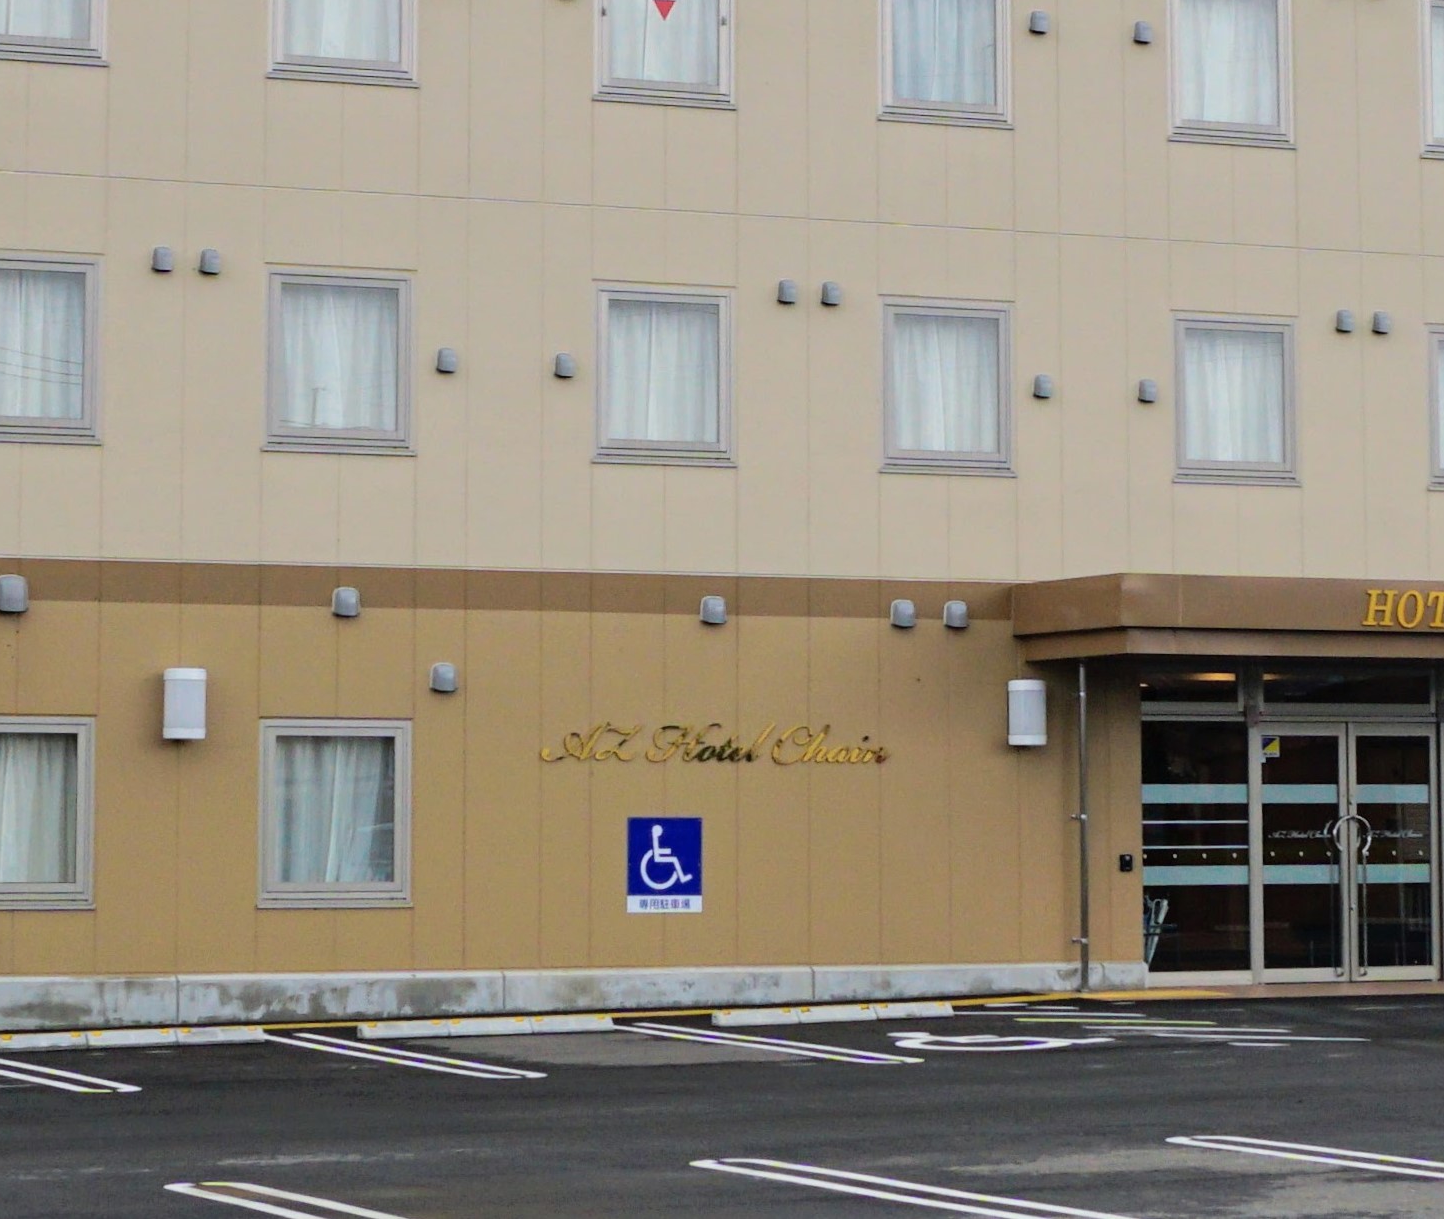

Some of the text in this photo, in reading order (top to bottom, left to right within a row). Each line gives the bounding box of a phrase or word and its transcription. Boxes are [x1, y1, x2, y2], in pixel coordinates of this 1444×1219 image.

[540, 721, 889, 765] AZ Hotel Chain
